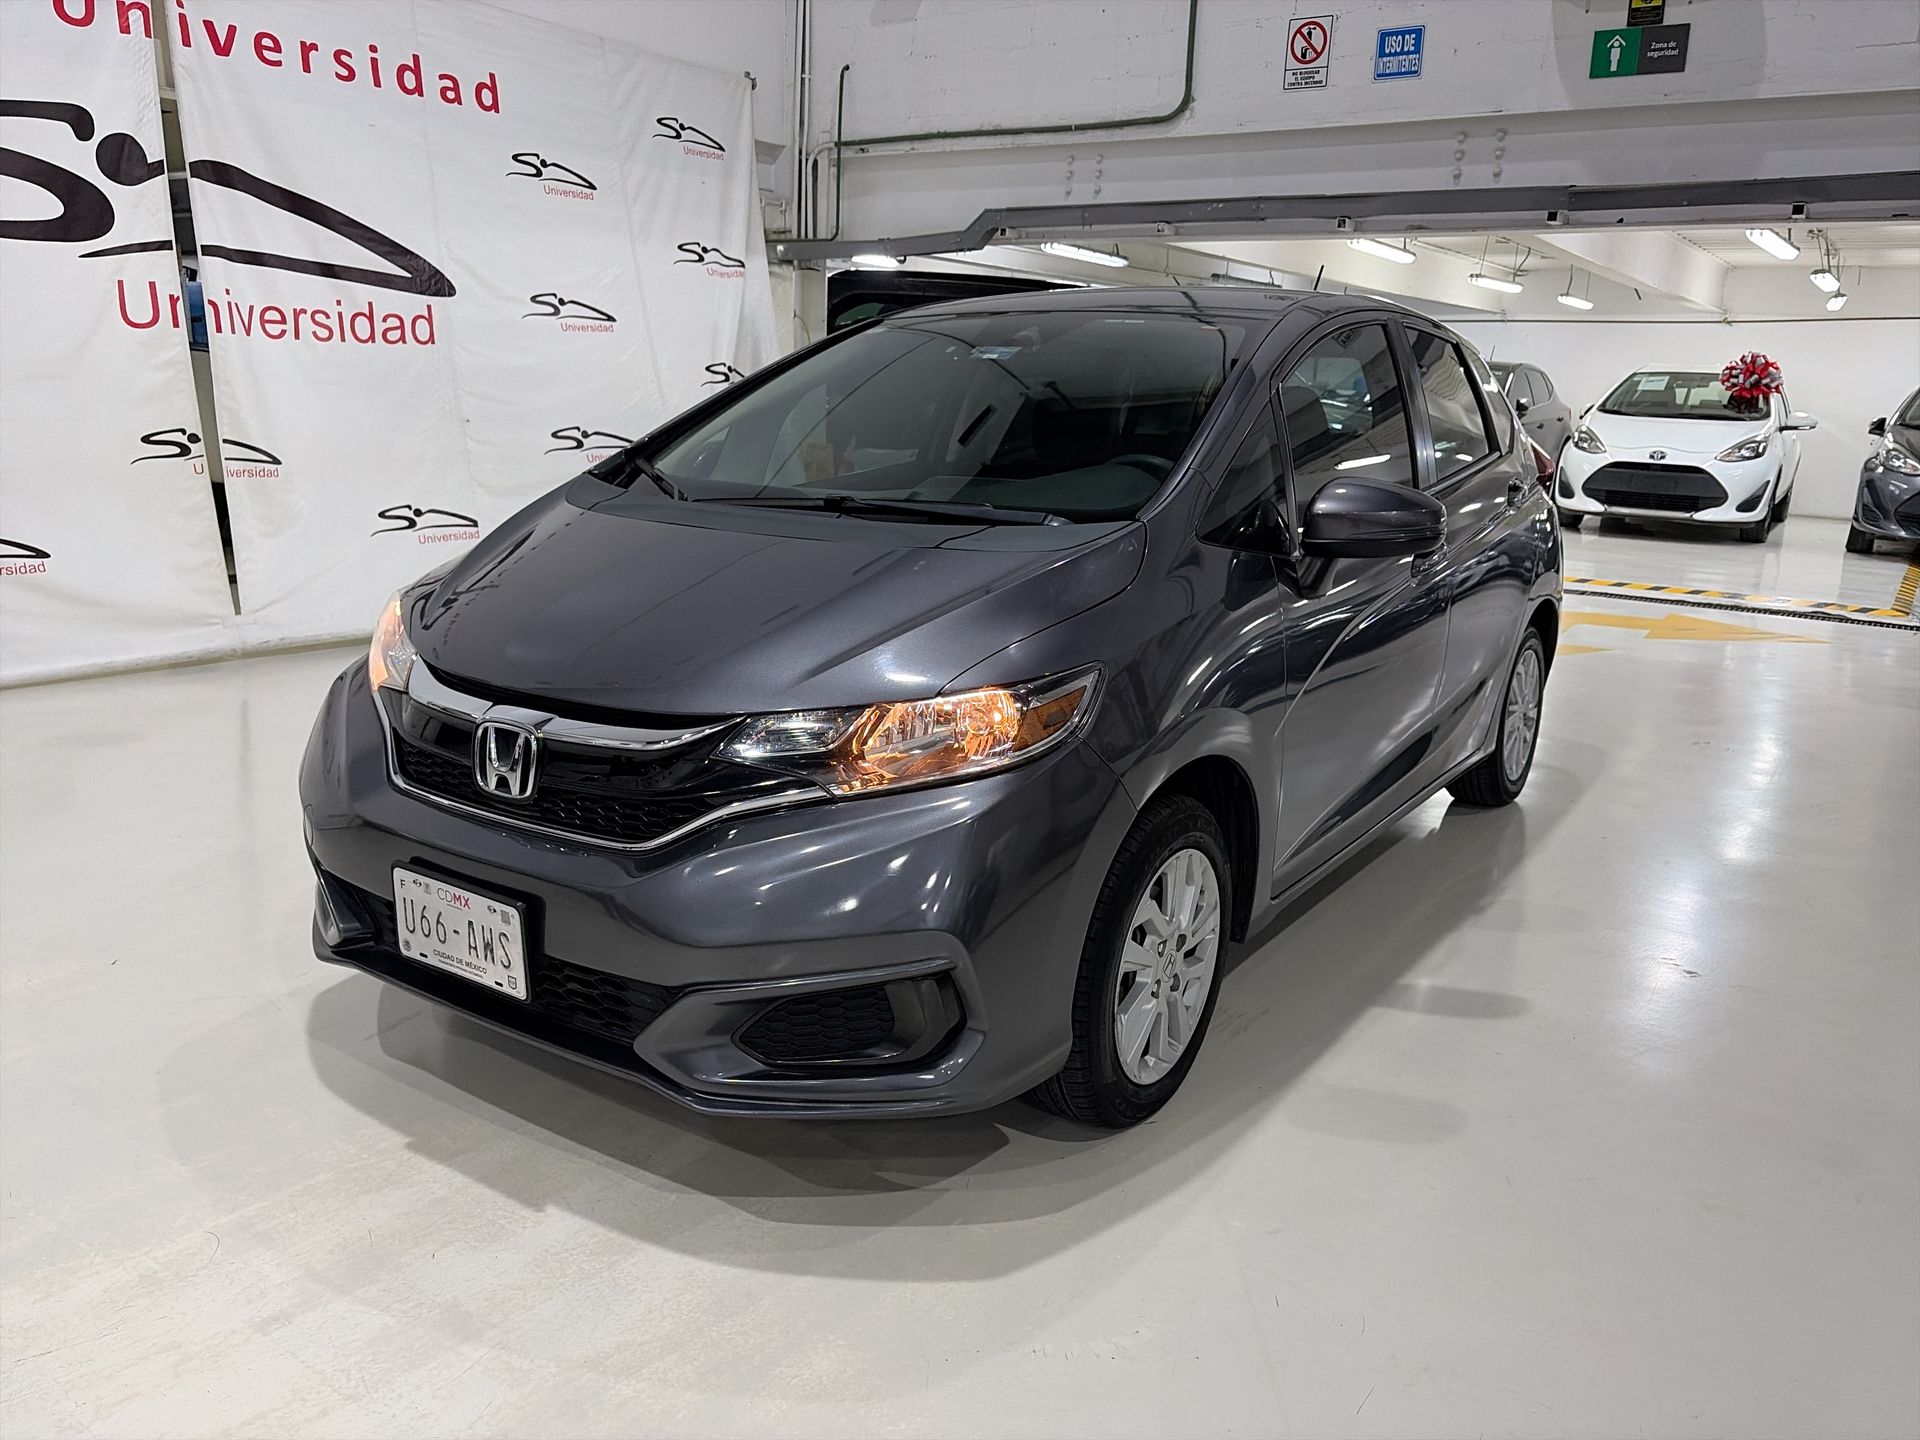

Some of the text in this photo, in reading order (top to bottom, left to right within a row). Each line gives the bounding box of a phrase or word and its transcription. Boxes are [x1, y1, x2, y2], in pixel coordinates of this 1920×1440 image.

[1384, 33, 1416, 54] USO DE
[1650, 40, 1677, 50] Zona de
[1646, 47, 1680, 59] seguridad
[1376, 53, 1420, 75] INTERMITENTES
[682, 145, 725, 161] Universidad
[543, 184, 595, 201] Universidad
[560, 322, 615, 333] Universidad
[193, 462, 279, 478] Uiversidad
[418, 530, 480, 545] Universidad
[400, 879, 406, 889] F
[436, 887, 471, 910] CDMX
[403, 896, 512, 970] U66-AWS
[433, 948, 455, 963] CIUDAD
[455, 956, 464, 966] DE
[464, 959, 488, 975] MÉXICO
